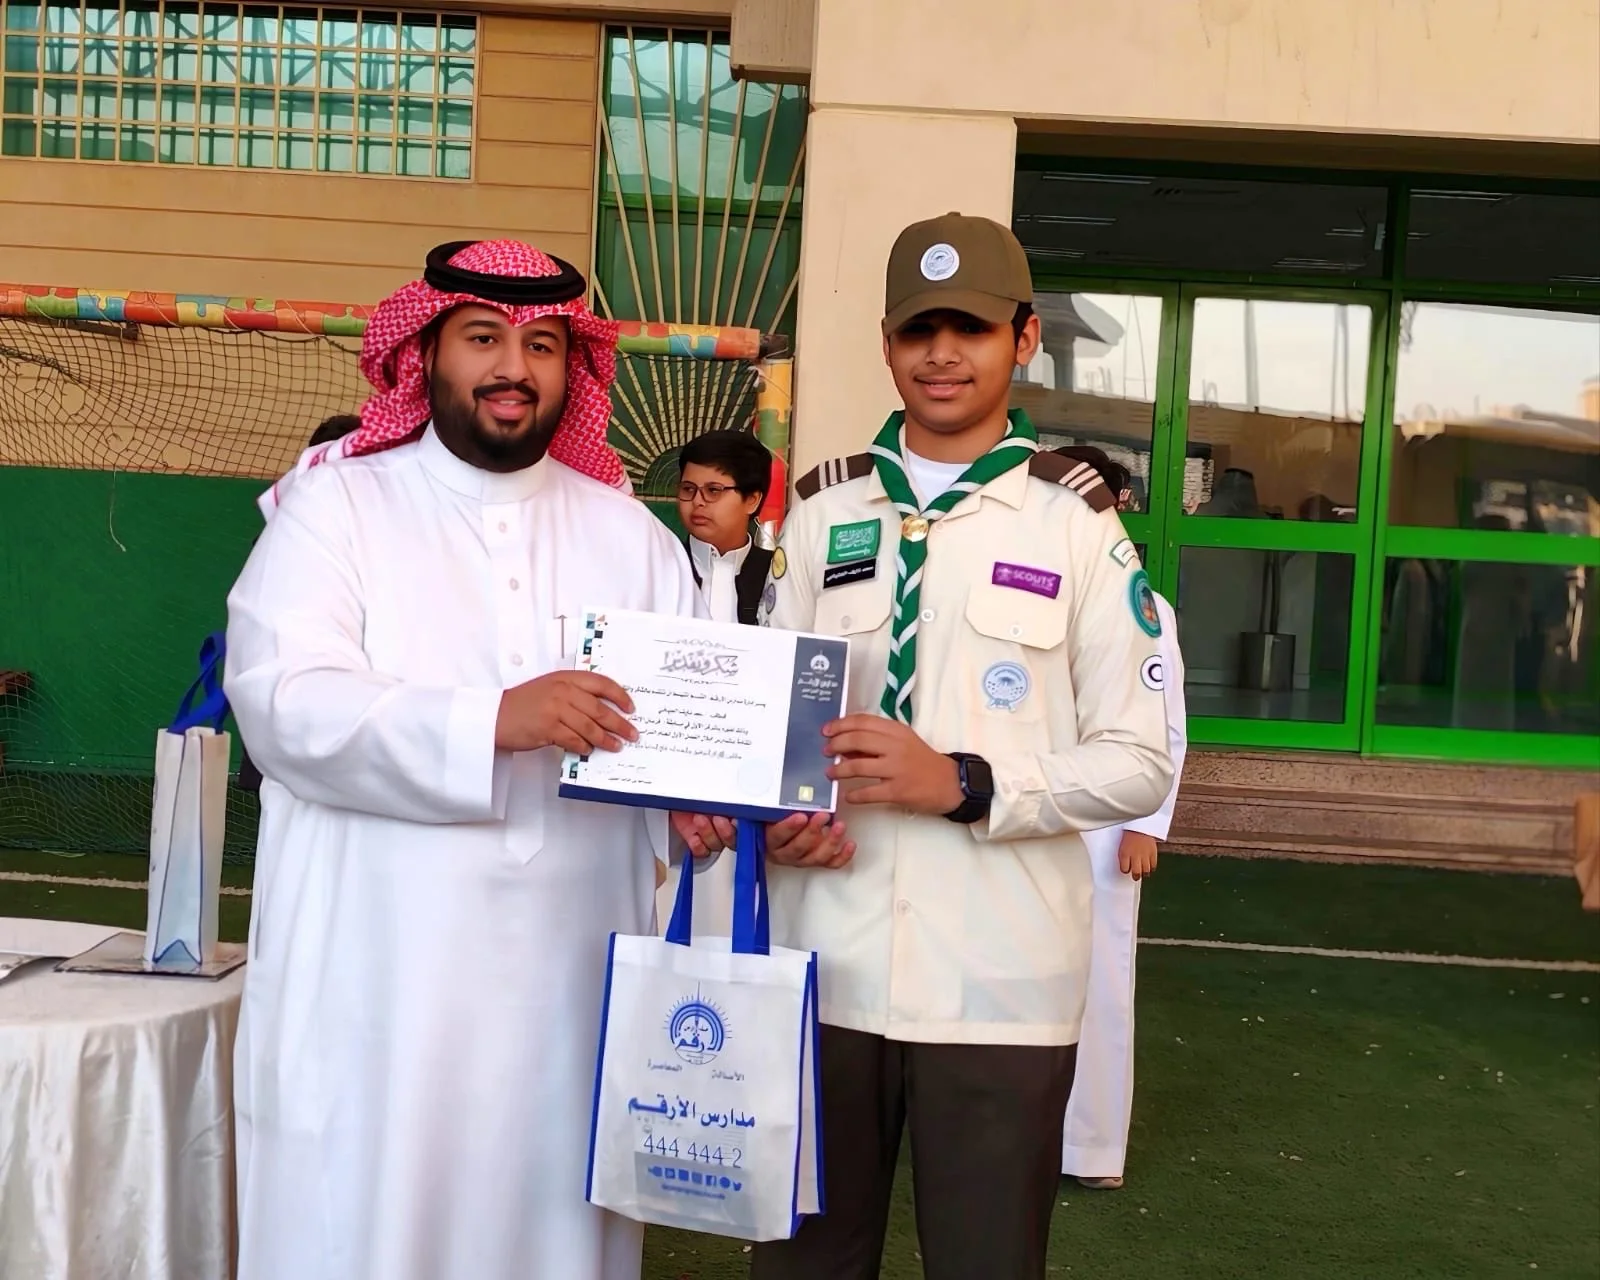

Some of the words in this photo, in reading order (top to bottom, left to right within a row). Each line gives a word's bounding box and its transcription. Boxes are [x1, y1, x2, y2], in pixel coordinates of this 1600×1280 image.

[1013, 570, 1056, 587] SCOUTS
[628, 1093, 696, 1120] الأرقم
[700, 1107, 755, 1128] مدارس
[643, 1133, 679, 1158] 444
[687, 1142, 723, 1166] 444
[732, 1147, 742, 1169] 2
